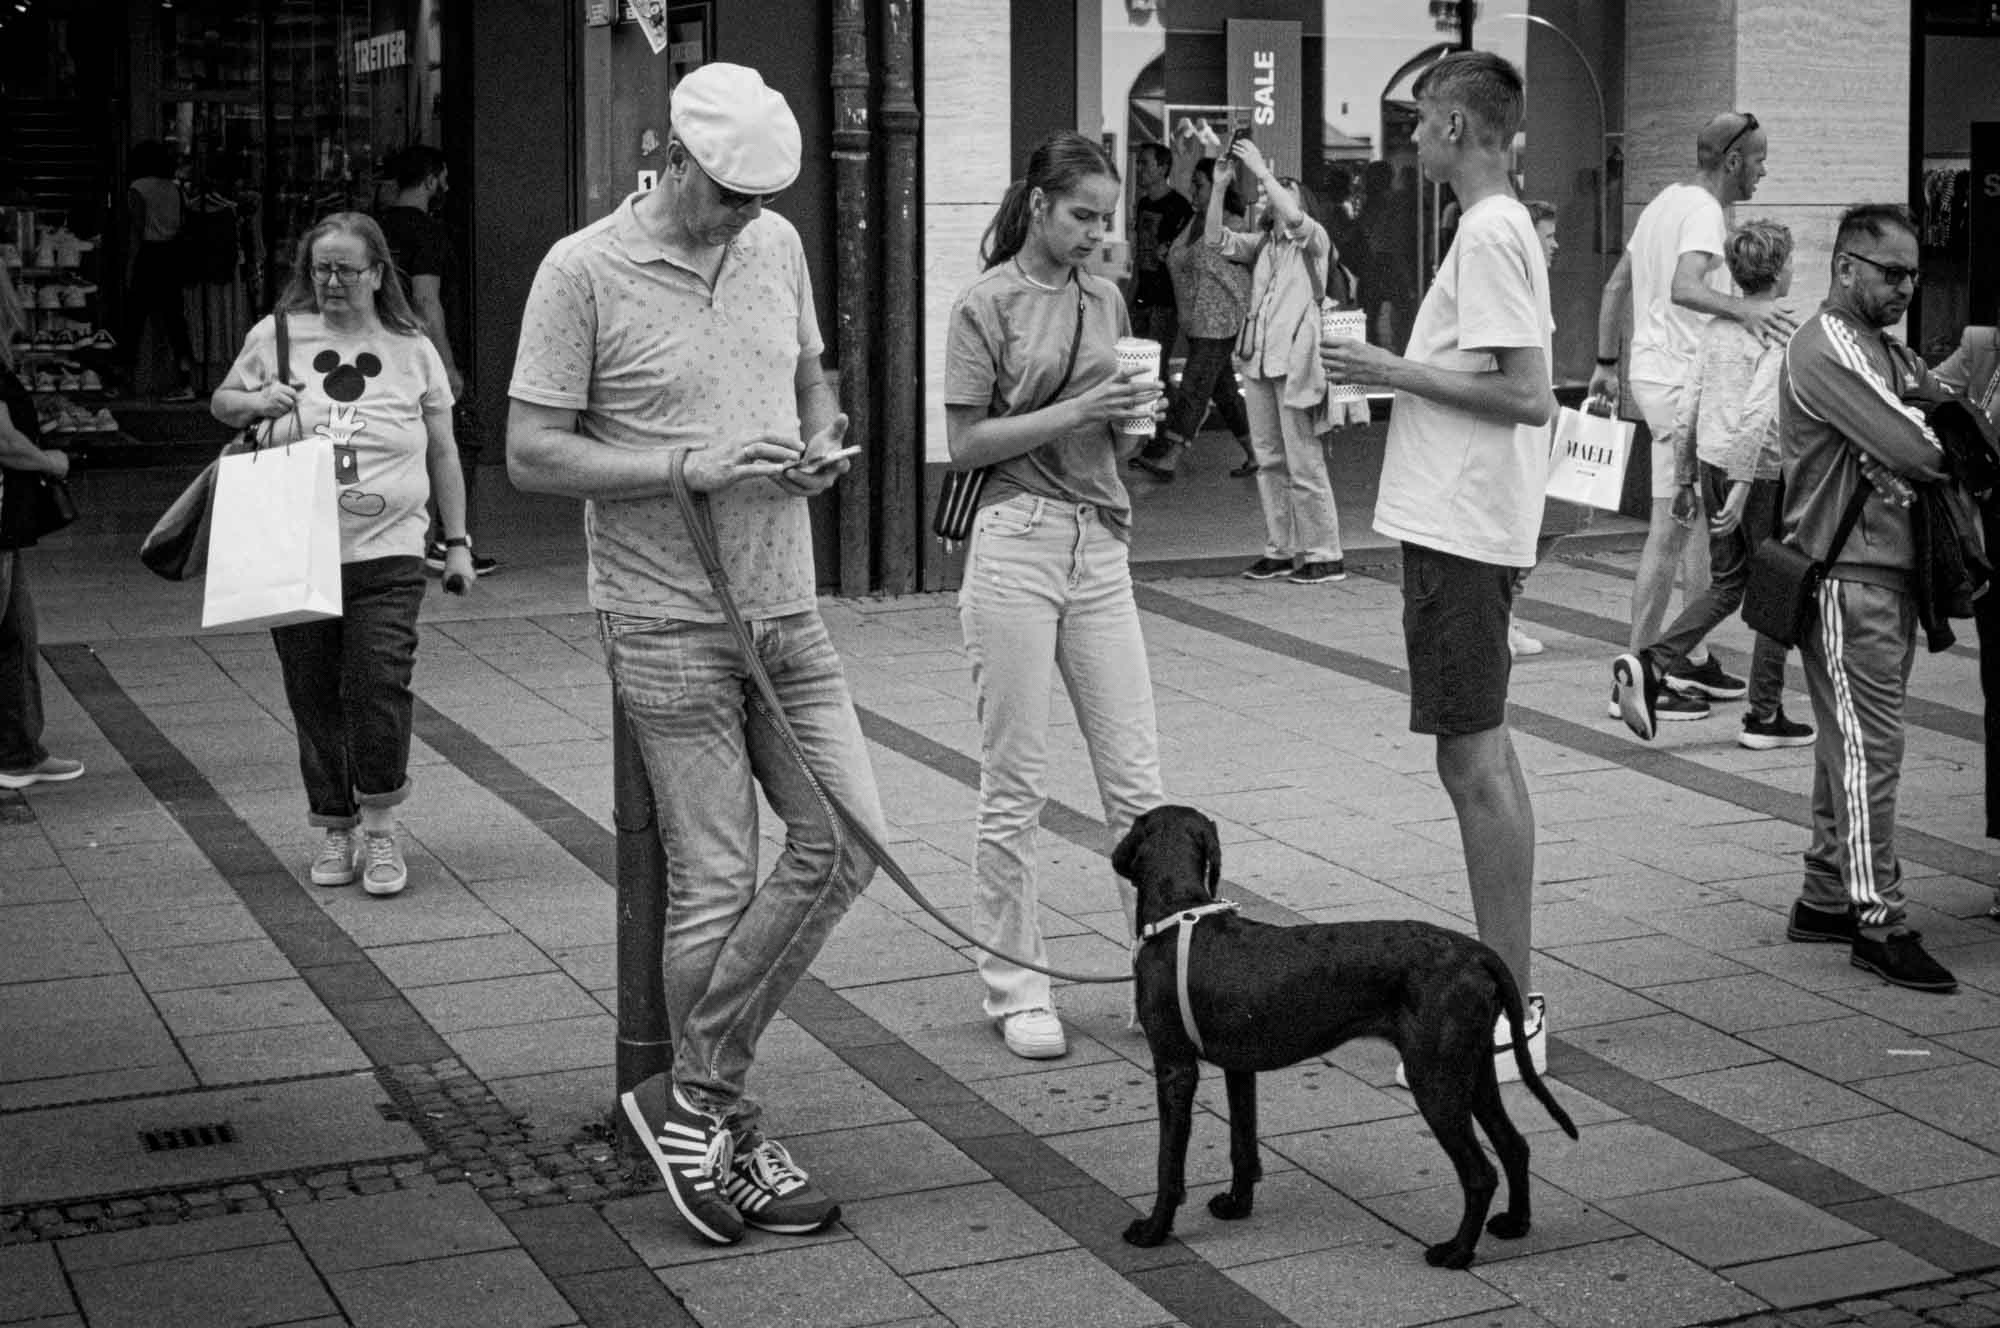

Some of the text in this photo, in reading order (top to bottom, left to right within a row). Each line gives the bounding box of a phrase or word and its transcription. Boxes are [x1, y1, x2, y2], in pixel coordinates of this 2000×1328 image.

[354, 30, 406, 74] TRETTER
[1253, 50, 1275, 126] SALE
[643, 175, 651, 190] 1
